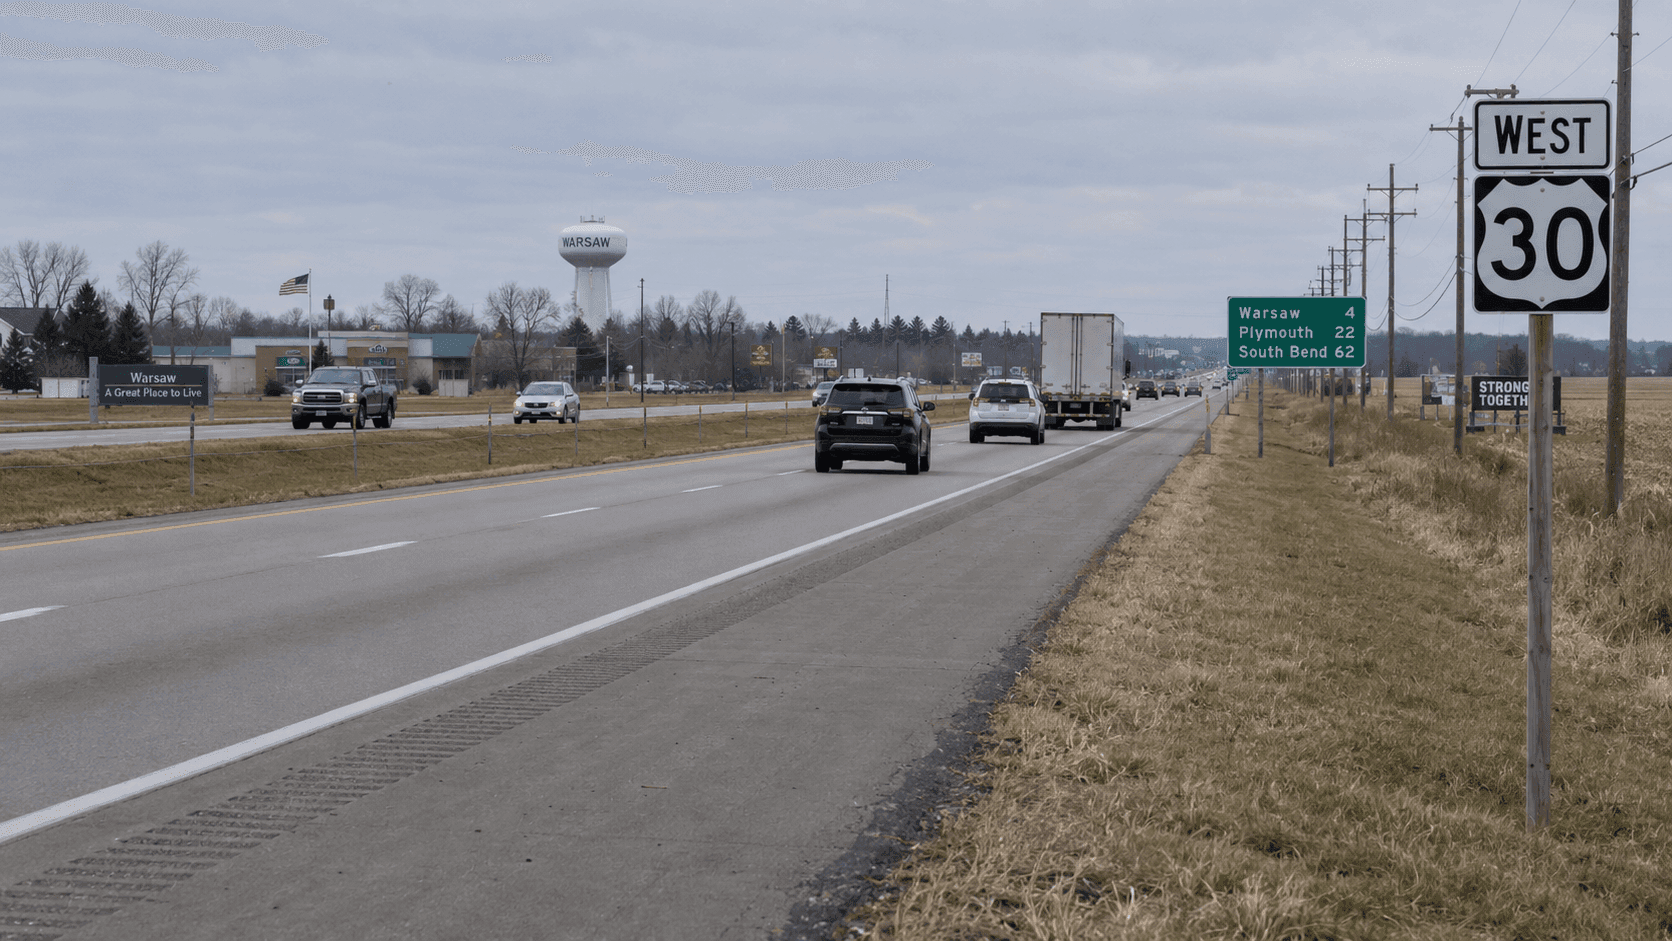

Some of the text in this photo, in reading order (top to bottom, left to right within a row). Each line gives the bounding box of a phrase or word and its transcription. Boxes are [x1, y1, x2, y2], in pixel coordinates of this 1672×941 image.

[1494, 115, 1591, 154] WEST
[562, 237, 611, 248] WARSAW
[1490, 206, 1594, 281] 30
[1239, 306, 1355, 319] Warsaw 4
[1239, 326, 1355, 342] Plymouth 22
[1239, 345, 1355, 358] South Bend 62
[130, 372, 176, 383] Warsaw
[104, 388, 202, 397] A Great Place to Live
[1479, 394, 1529, 406] TOGETH
